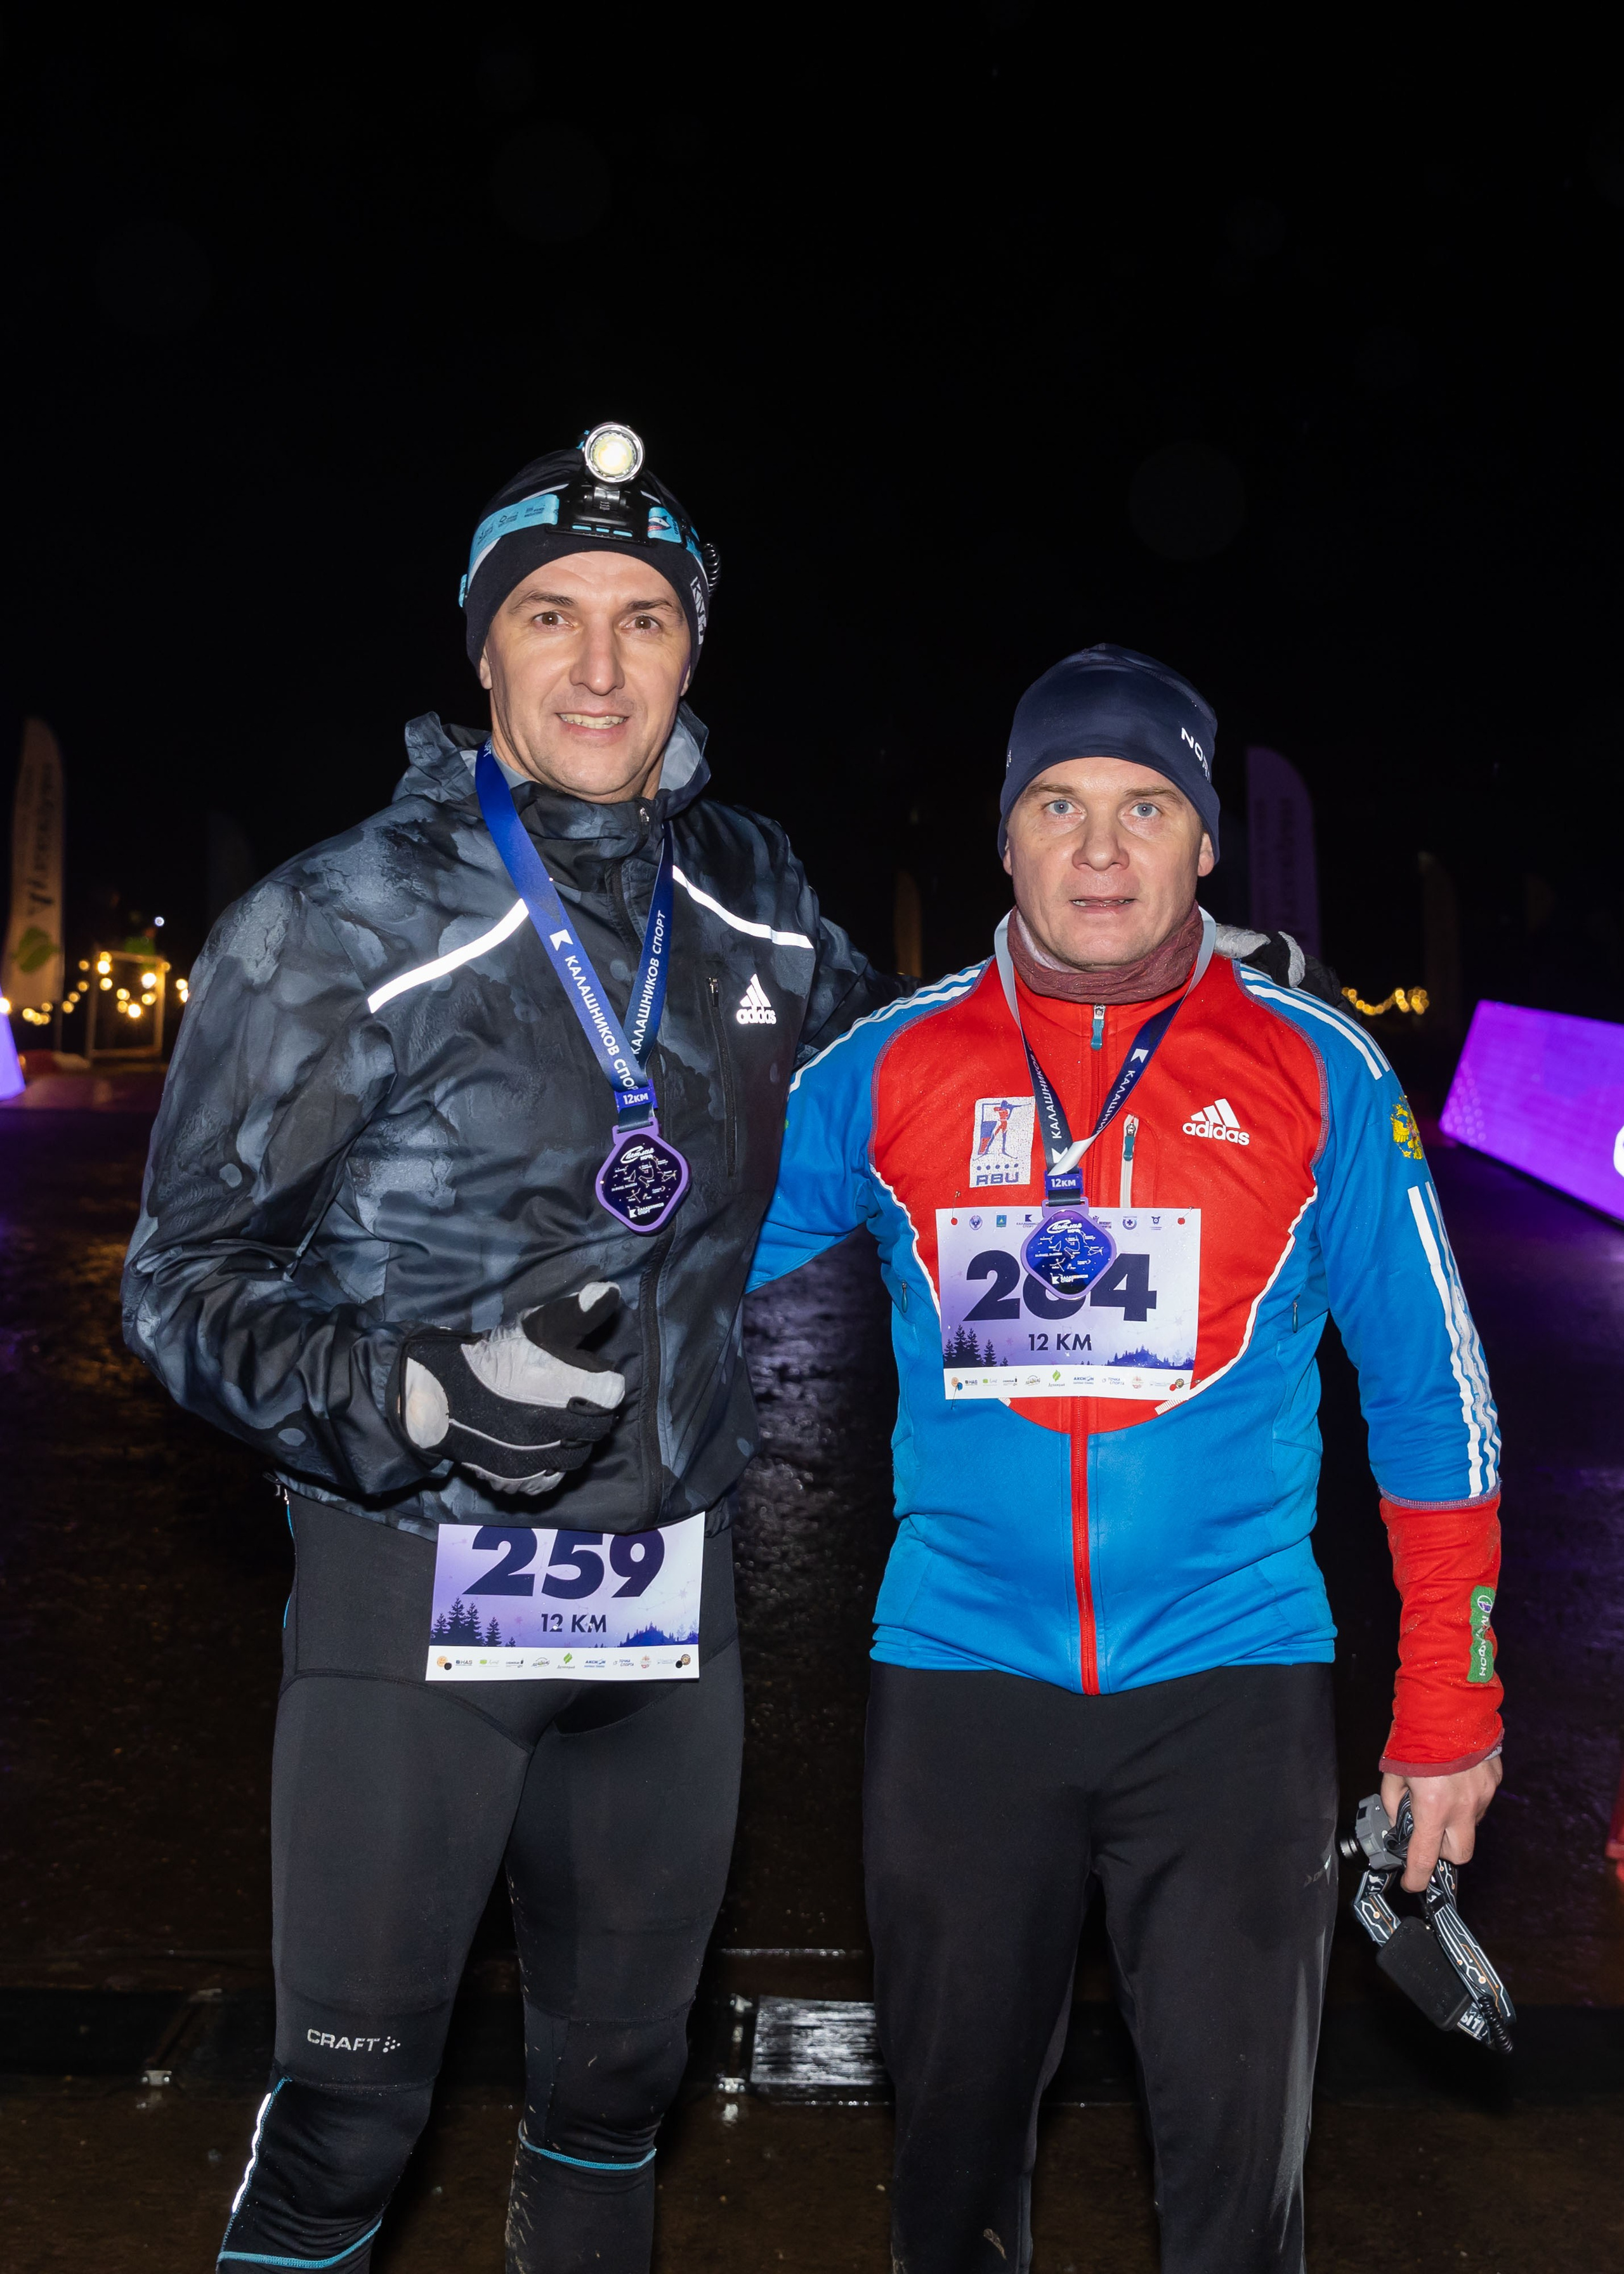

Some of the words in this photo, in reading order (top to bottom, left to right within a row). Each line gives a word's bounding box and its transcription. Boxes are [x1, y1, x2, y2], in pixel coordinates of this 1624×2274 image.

[653, 910, 665, 955] СПОРТ
[565, 955, 620, 1056] КАЛАШНИКОВ
[613, 1058, 639, 1089] СПОР
[736, 1005, 777, 1025] adidas
[1030, 1054, 1062, 1139] КАЛАШНИКОВ
[1182, 1119, 1250, 1146] adidas
[1028, 1333, 1049, 1351] 12
[462, 1525, 665, 1600] 259
[541, 1613, 563, 1633] 12
[306, 2028, 381, 2052] CRAFT
